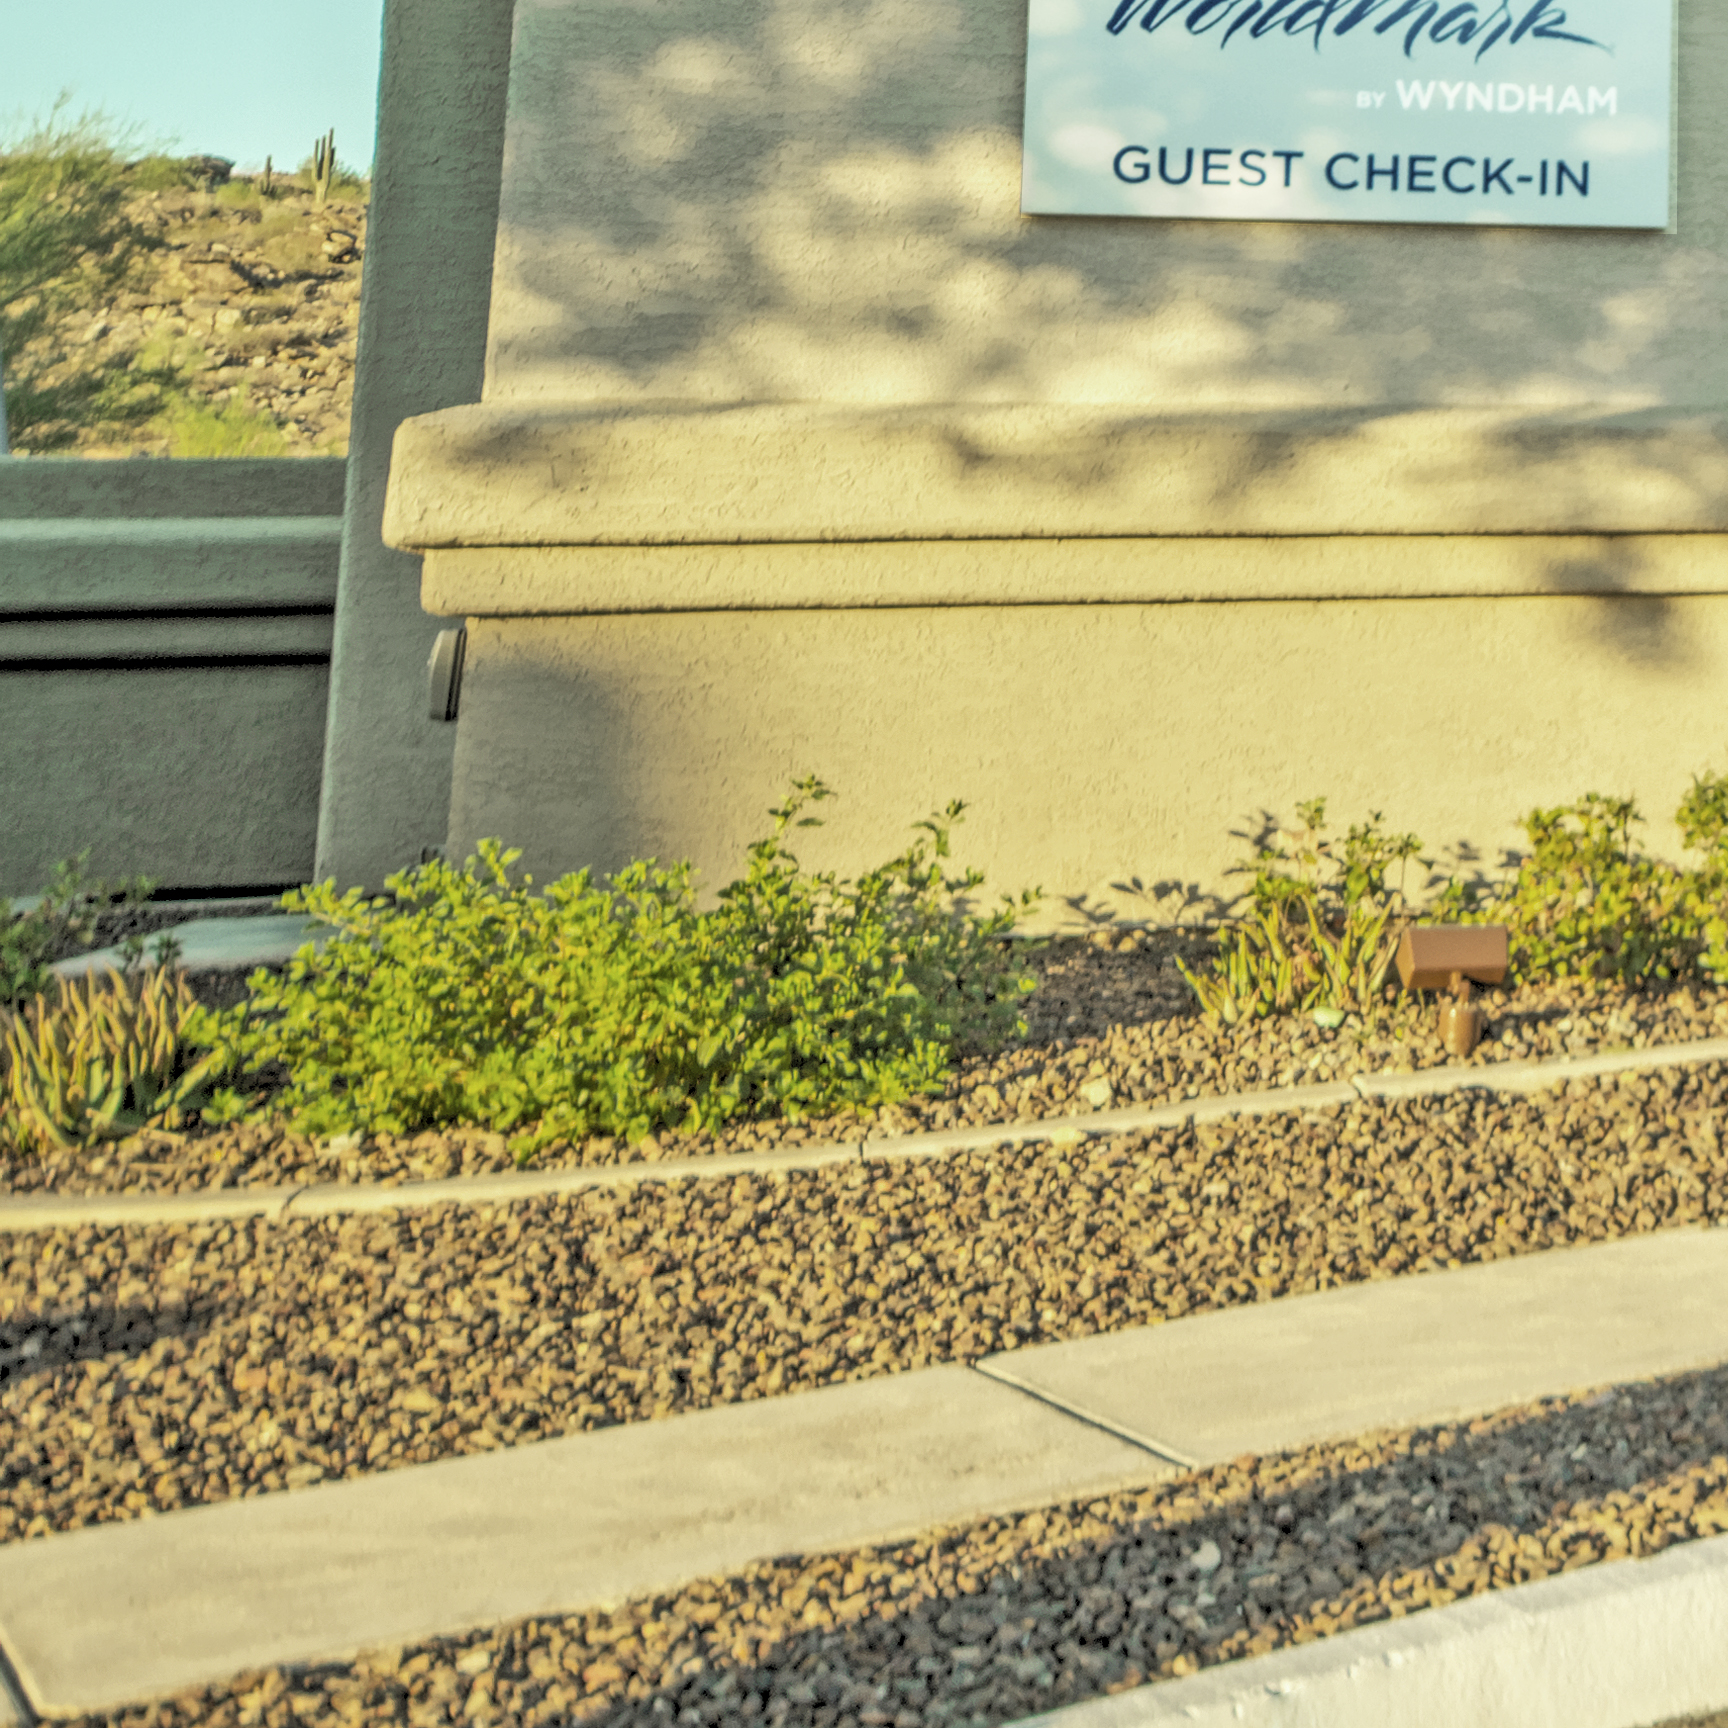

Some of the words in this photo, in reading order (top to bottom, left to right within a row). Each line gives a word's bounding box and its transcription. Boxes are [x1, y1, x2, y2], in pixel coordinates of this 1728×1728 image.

[1356, 90, 1386, 110] BY
[1395, 79, 1618, 116] WYNDHAM
[1112, 145, 1304, 188] GUEST
[1324, 152, 1591, 198] CHECK-IN
